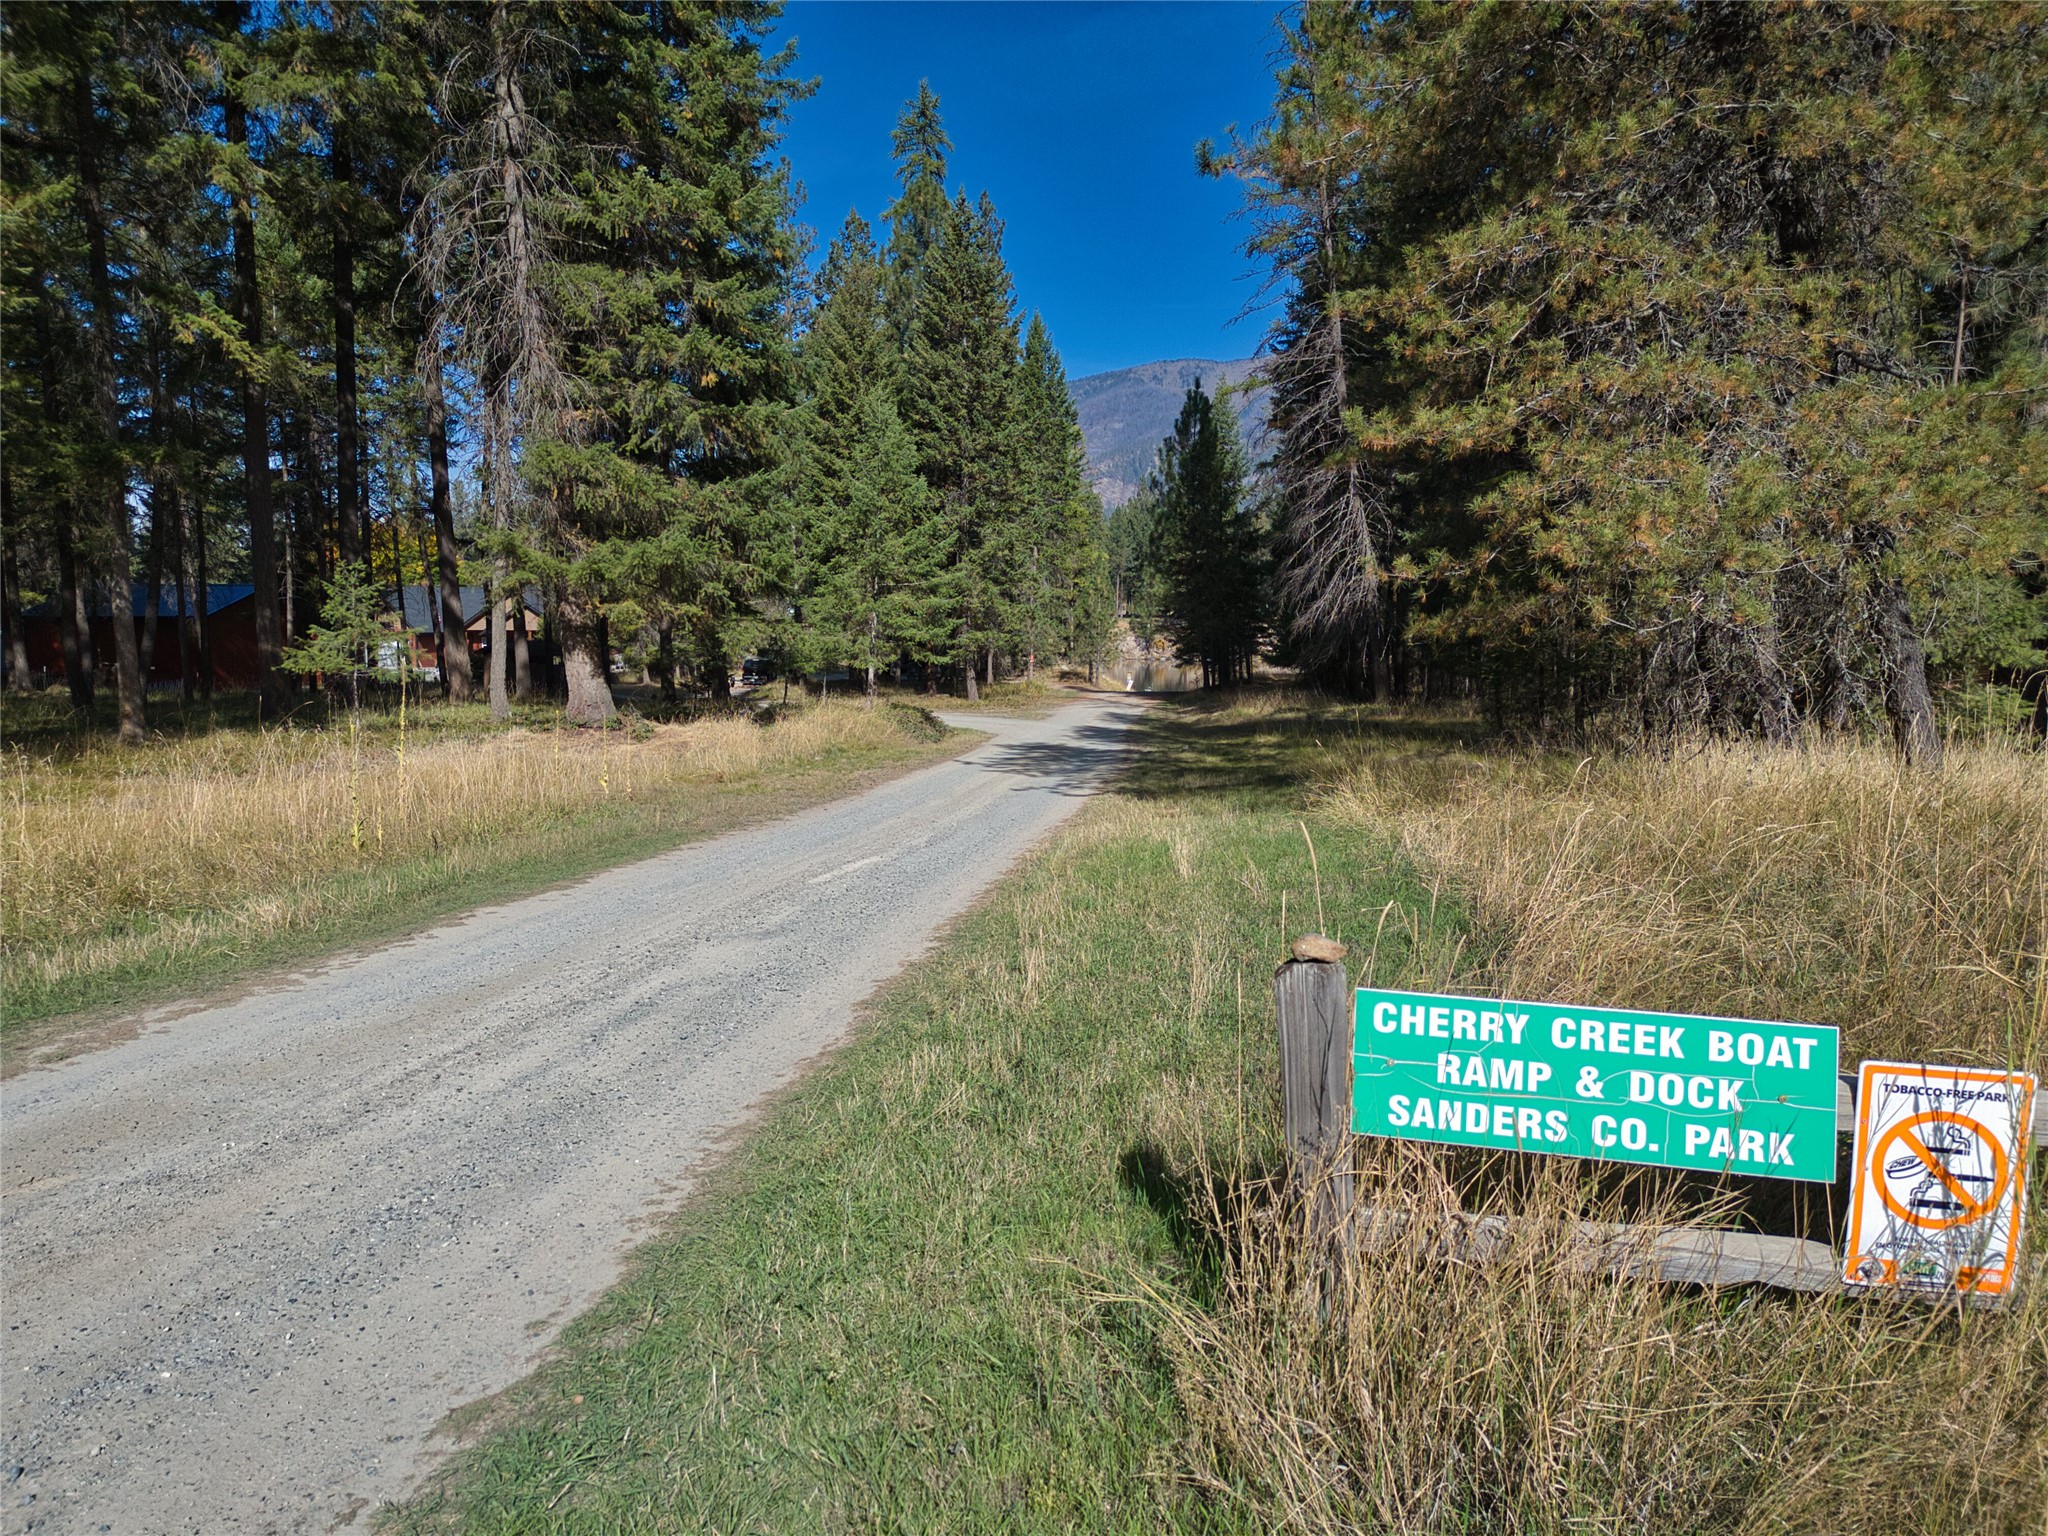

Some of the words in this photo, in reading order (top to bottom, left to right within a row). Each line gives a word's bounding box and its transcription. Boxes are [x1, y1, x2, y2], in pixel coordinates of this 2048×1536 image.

[1373, 1001, 1530, 1044] CHERRY
[1551, 1017, 1686, 1059] CREEK
[1708, 1030, 1819, 1070] BOAT
[1437, 1053, 1552, 1093] RAMP
[1575, 1065, 1604, 1098] &
[1629, 1070, 1745, 1111] DOCK
[1883, 1083, 1974, 1100] TOBACCO-FREE
[1388, 1094, 1568, 1142] SANDERS
[1592, 1115, 1660, 1152] CO.
[1685, 1124, 1795, 1166] PARK
[1889, 1157, 1916, 1170] CHEW
